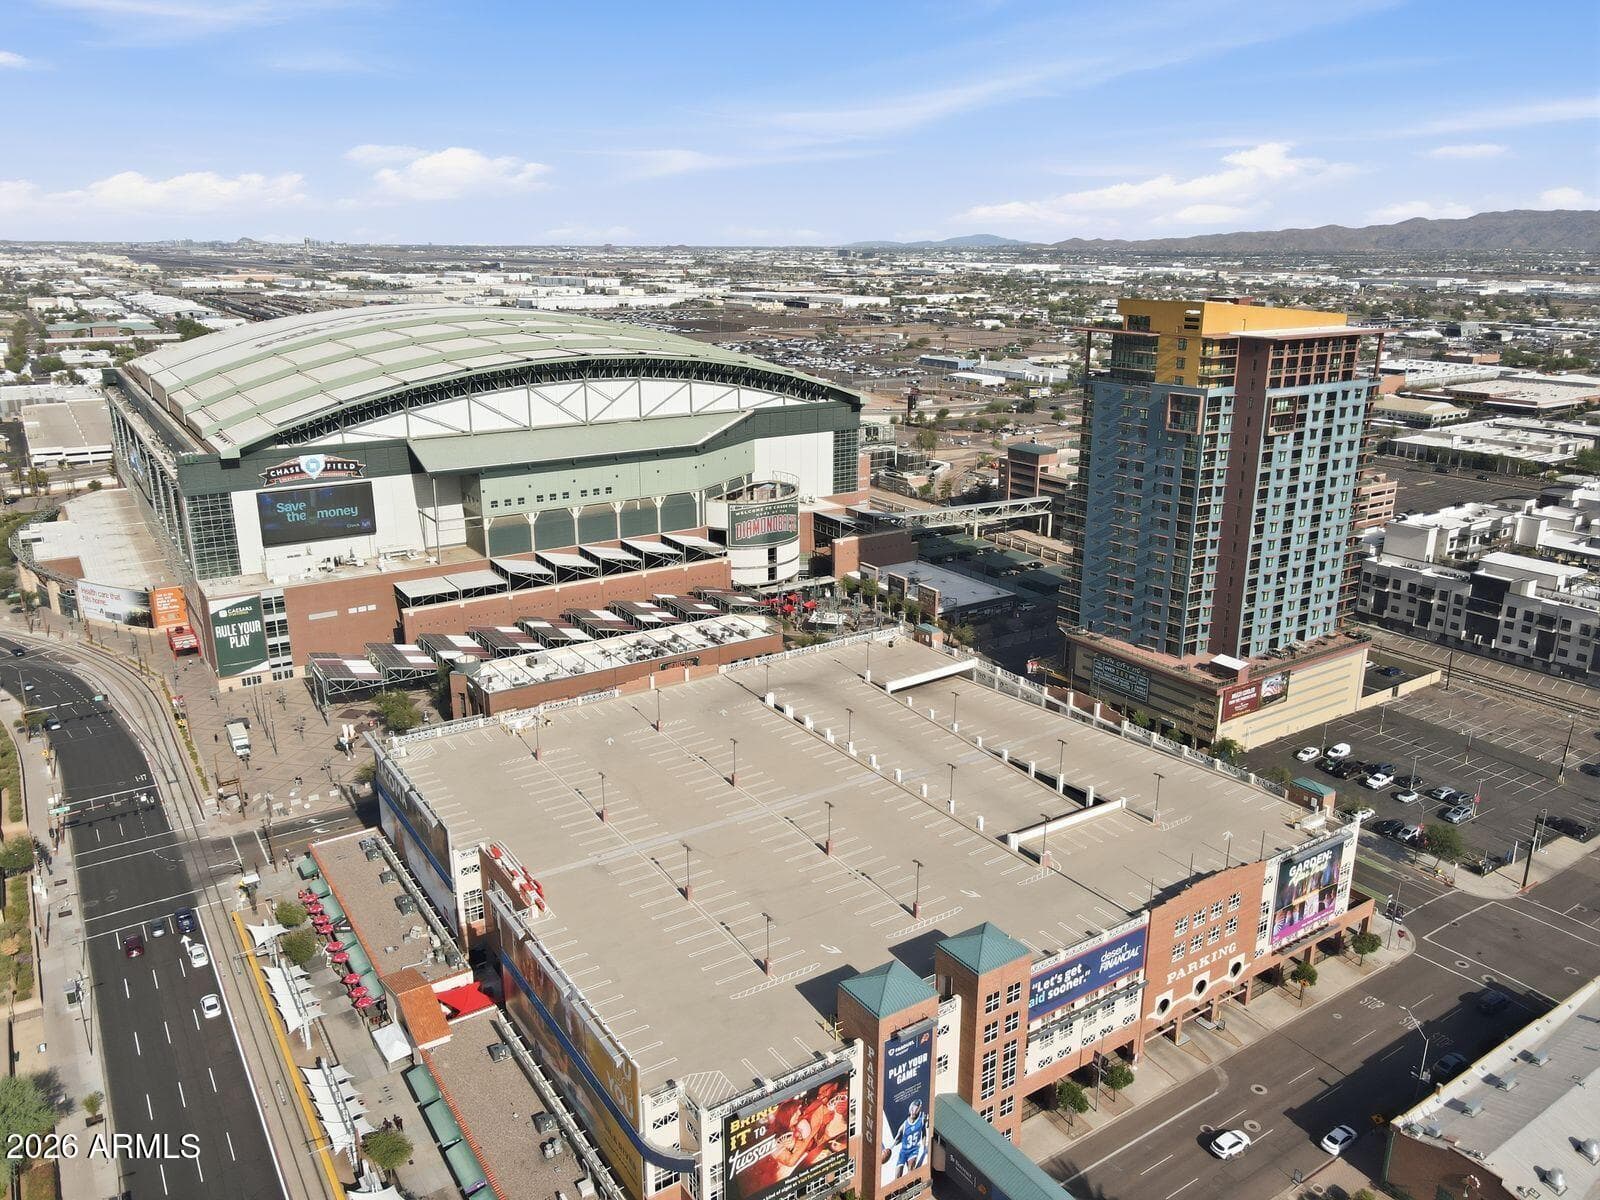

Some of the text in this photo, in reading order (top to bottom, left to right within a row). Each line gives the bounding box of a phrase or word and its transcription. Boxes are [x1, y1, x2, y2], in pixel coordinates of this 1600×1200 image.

[269, 465, 300, 477] CHASE
[276, 502, 306, 513] Save
[287, 506, 358, 522] the money
[215, 620, 262, 638] RULE YOUR
[229, 634, 250, 648] PLAY
[1289, 849, 1333, 877] GARDEN:
[1099, 946, 1140, 974] FINANCIAL
[1101, 942, 1129, 962] desert
[1064, 963, 1083, 981] get
[1166, 942, 1237, 985] PARKING
[1360, 995, 1385, 1009] STOP
[888, 1062, 907, 1080] PLAY
[908, 1052, 928, 1069] YOUR
[865, 1045, 876, 1144] PARKING
[729, 1104, 779, 1134] BRING
[730, 1126, 767, 1151] IT TO
[906, 1132, 918, 1150] 35
[728, 1136, 777, 1180] Tucson
